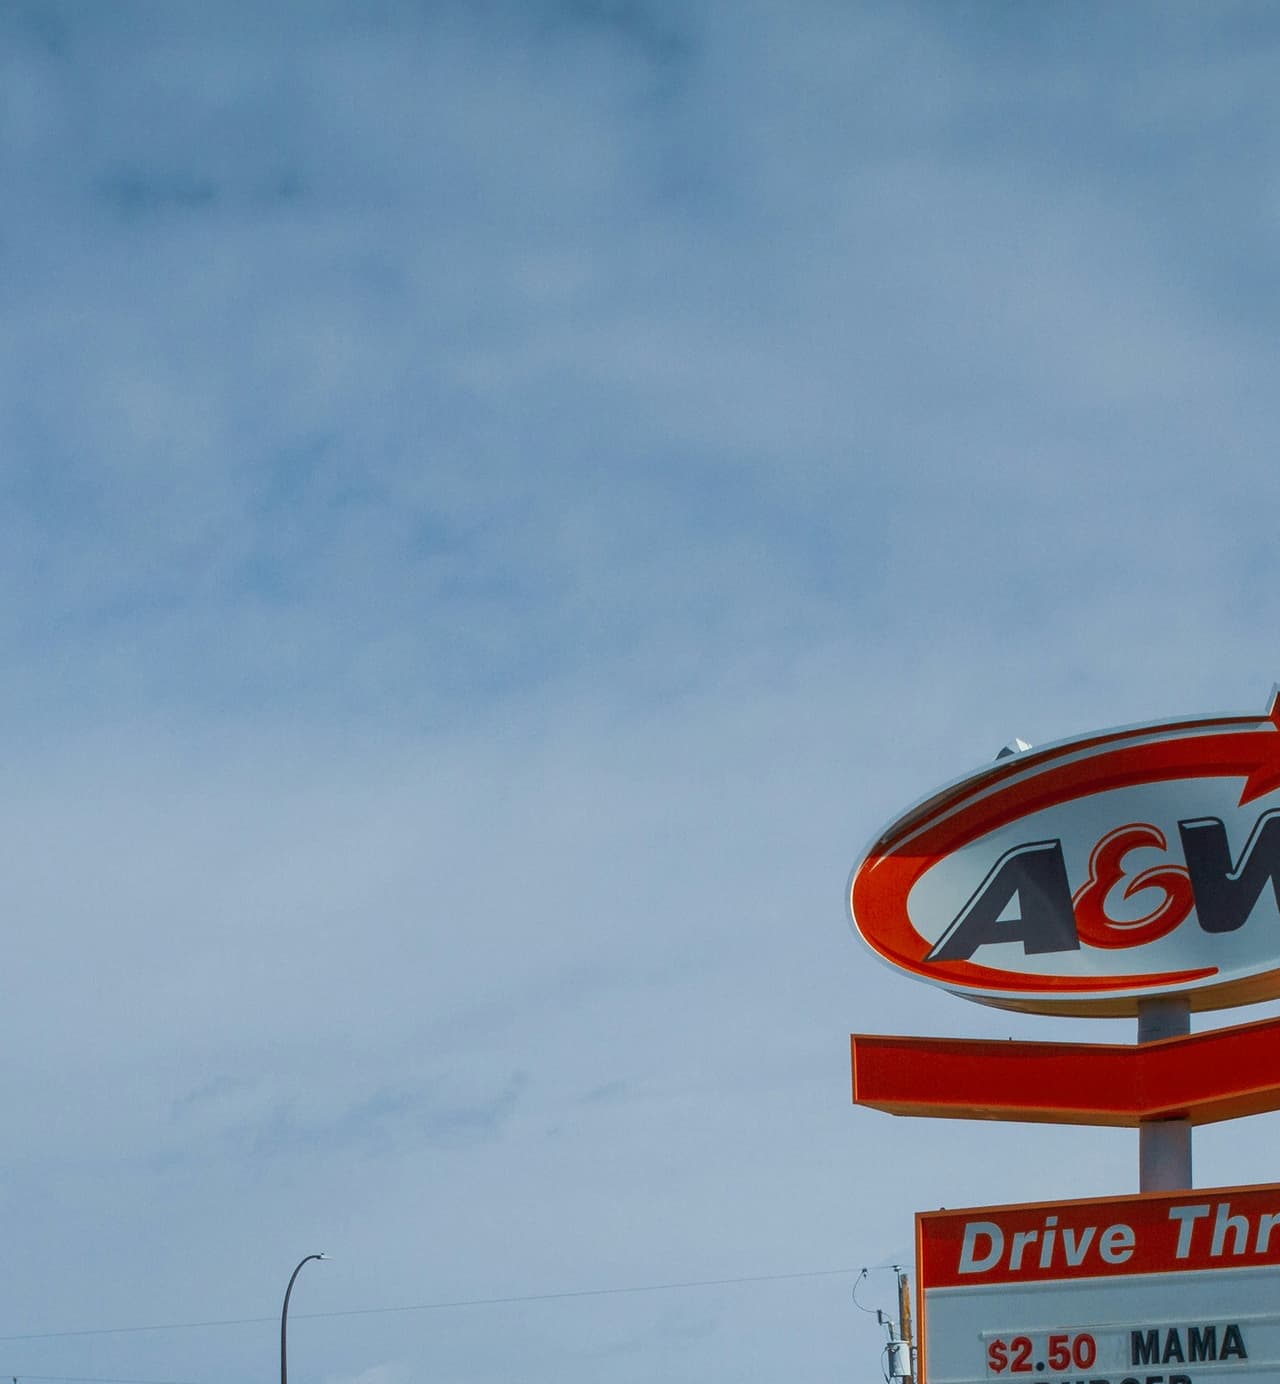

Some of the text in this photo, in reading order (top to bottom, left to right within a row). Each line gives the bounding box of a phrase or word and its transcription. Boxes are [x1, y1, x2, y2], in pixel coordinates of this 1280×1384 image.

[957, 1215, 1137, 1274] Drive
[987, 1324, 1248, 1374] $2.50 MAMA
